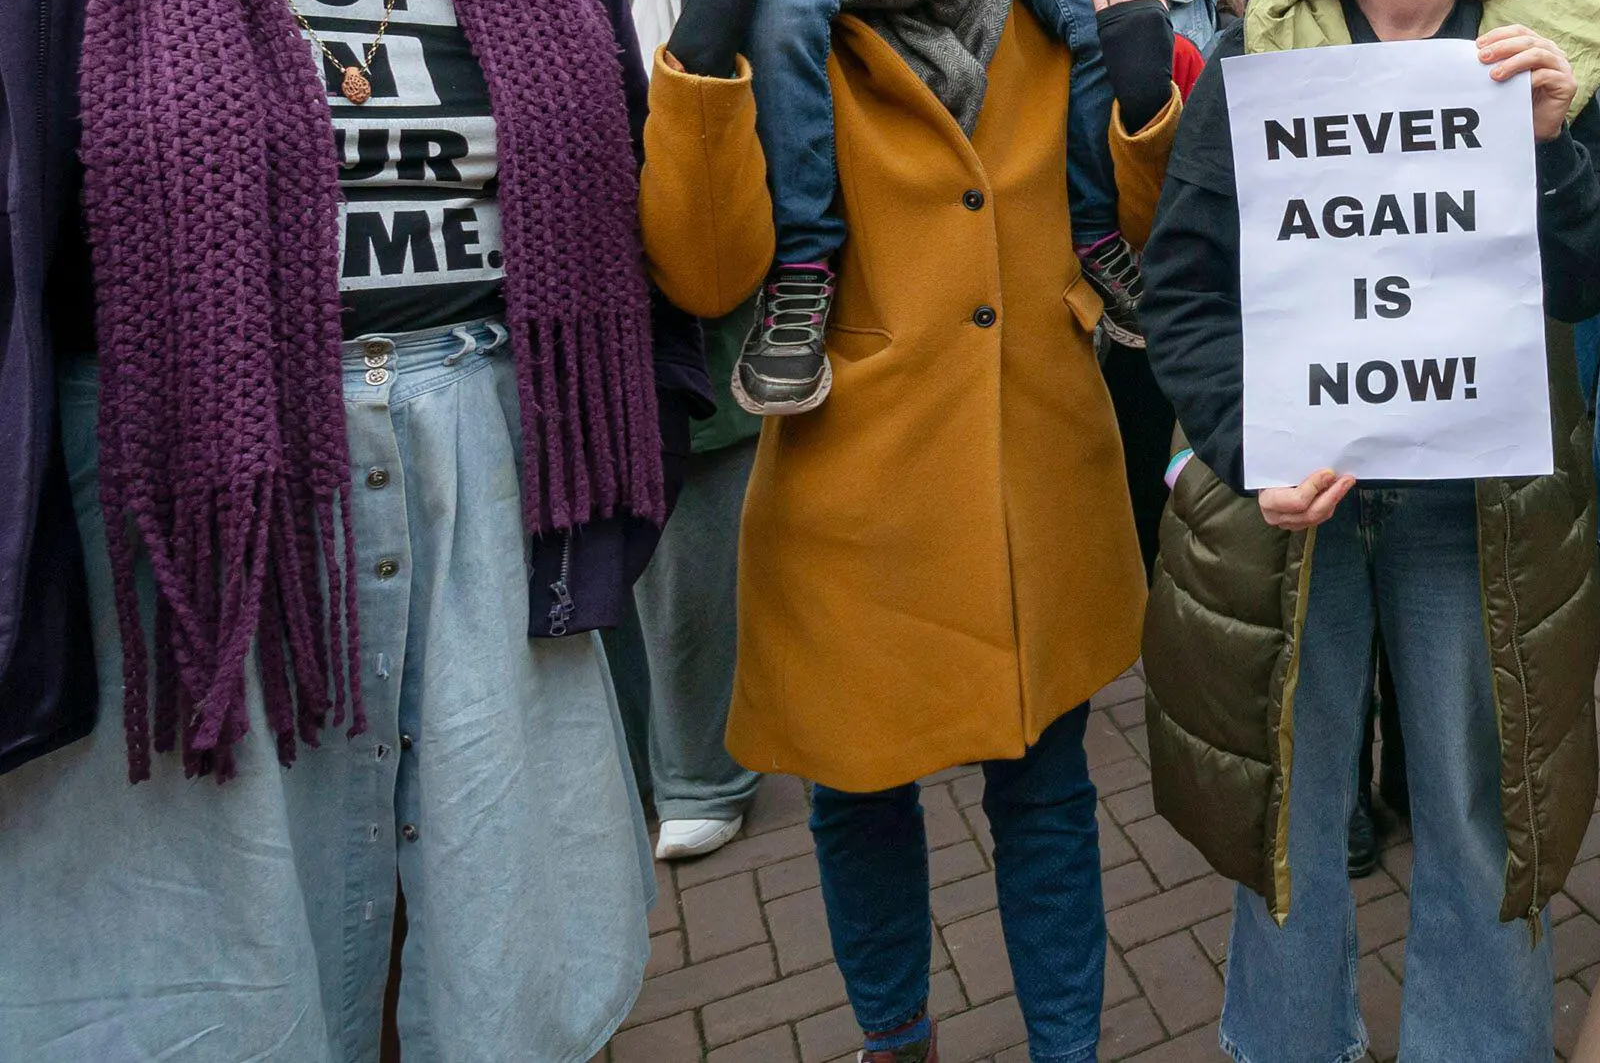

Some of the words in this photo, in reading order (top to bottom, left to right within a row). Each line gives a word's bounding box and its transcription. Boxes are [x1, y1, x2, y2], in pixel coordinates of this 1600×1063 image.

[333, 128, 470, 182] UR
[1263, 107, 1483, 161] NEVER
[1276, 189, 1477, 241] AGAIN
[342, 208, 505, 279] ME.
[1353, 275, 1412, 320] IS
[1308, 356, 1478, 406] NOW!
